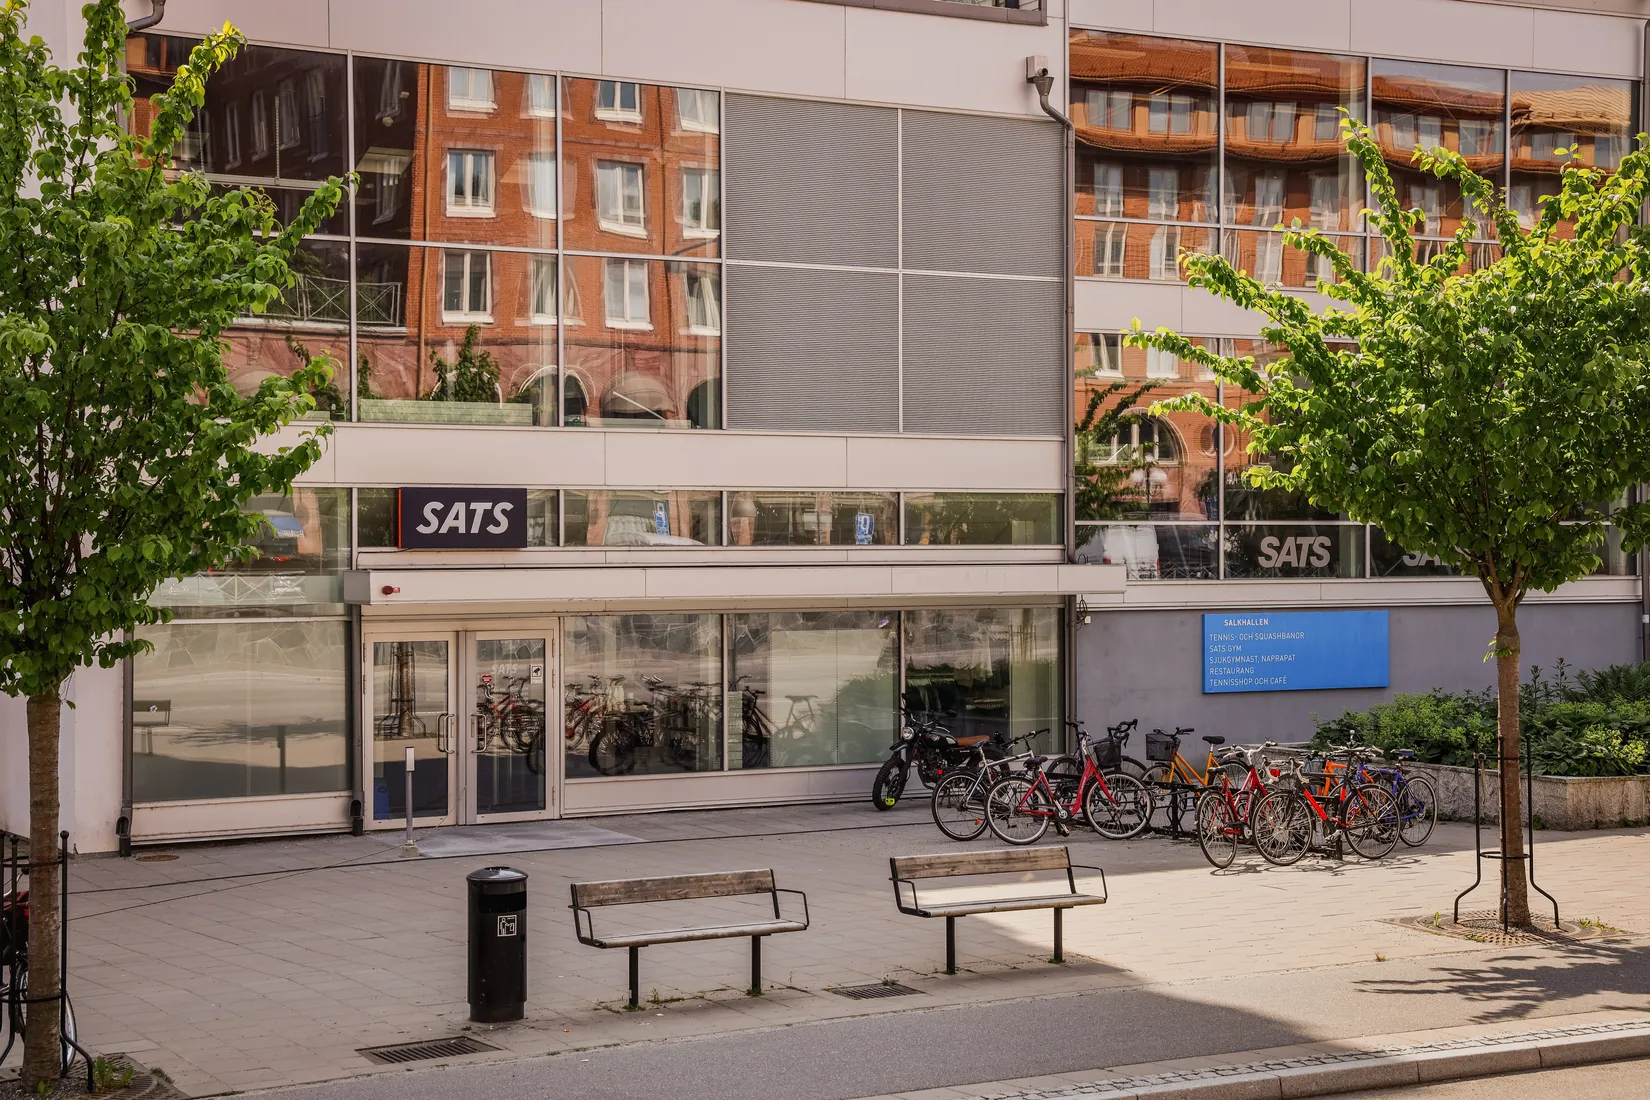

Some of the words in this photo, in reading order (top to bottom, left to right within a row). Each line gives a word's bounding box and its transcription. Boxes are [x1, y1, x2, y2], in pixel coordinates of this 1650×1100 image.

[415, 501, 514, 535] SATS
[1257, 535, 1332, 568] SATS
[1224, 618, 1269, 627] SALKHALLEN
[1209, 633, 1237, 642] TENNIS-
[1239, 632, 1253, 641] OCH
[1254, 631, 1305, 641] SQUASHBANOR
[1209, 645, 1226, 653] SATS
[1227, 644, 1242, 652] GYM
[1209, 655, 1260, 664] SJUKGYMNAST,
[1261, 654, 1296, 663] NAPRAPAT
[490, 663, 518, 675] SATS
[1209, 666, 1255, 675] RESTAURANG
[1209, 677, 1253, 687] TENNISSHOP
[1254, 677, 1269, 685] OCH
[1269, 675, 1288, 685] CAFÉ
